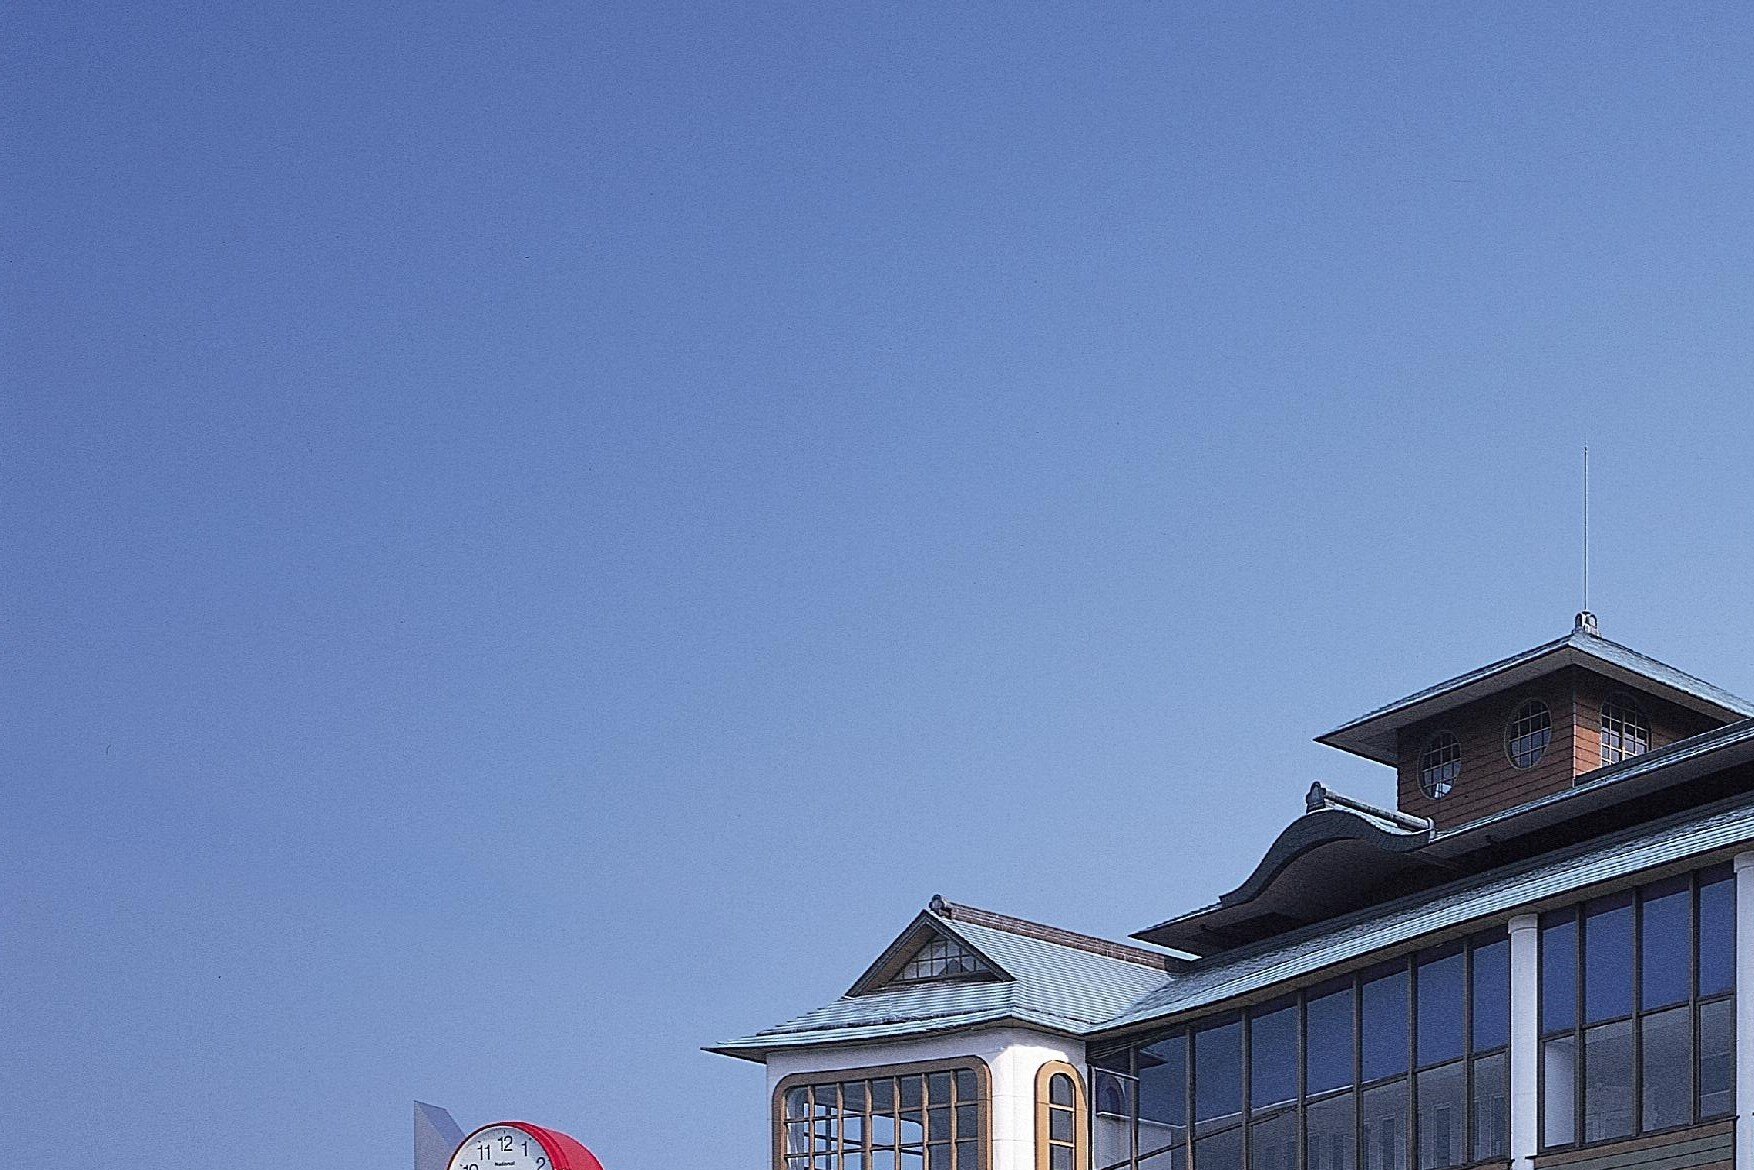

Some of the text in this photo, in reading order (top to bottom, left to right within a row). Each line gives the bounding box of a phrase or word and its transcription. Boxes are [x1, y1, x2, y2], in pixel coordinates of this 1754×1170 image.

[477, 1143, 491, 1161] 11
[497, 1134, 513, 1152] 12
[521, 1140, 528, 1157] 1
